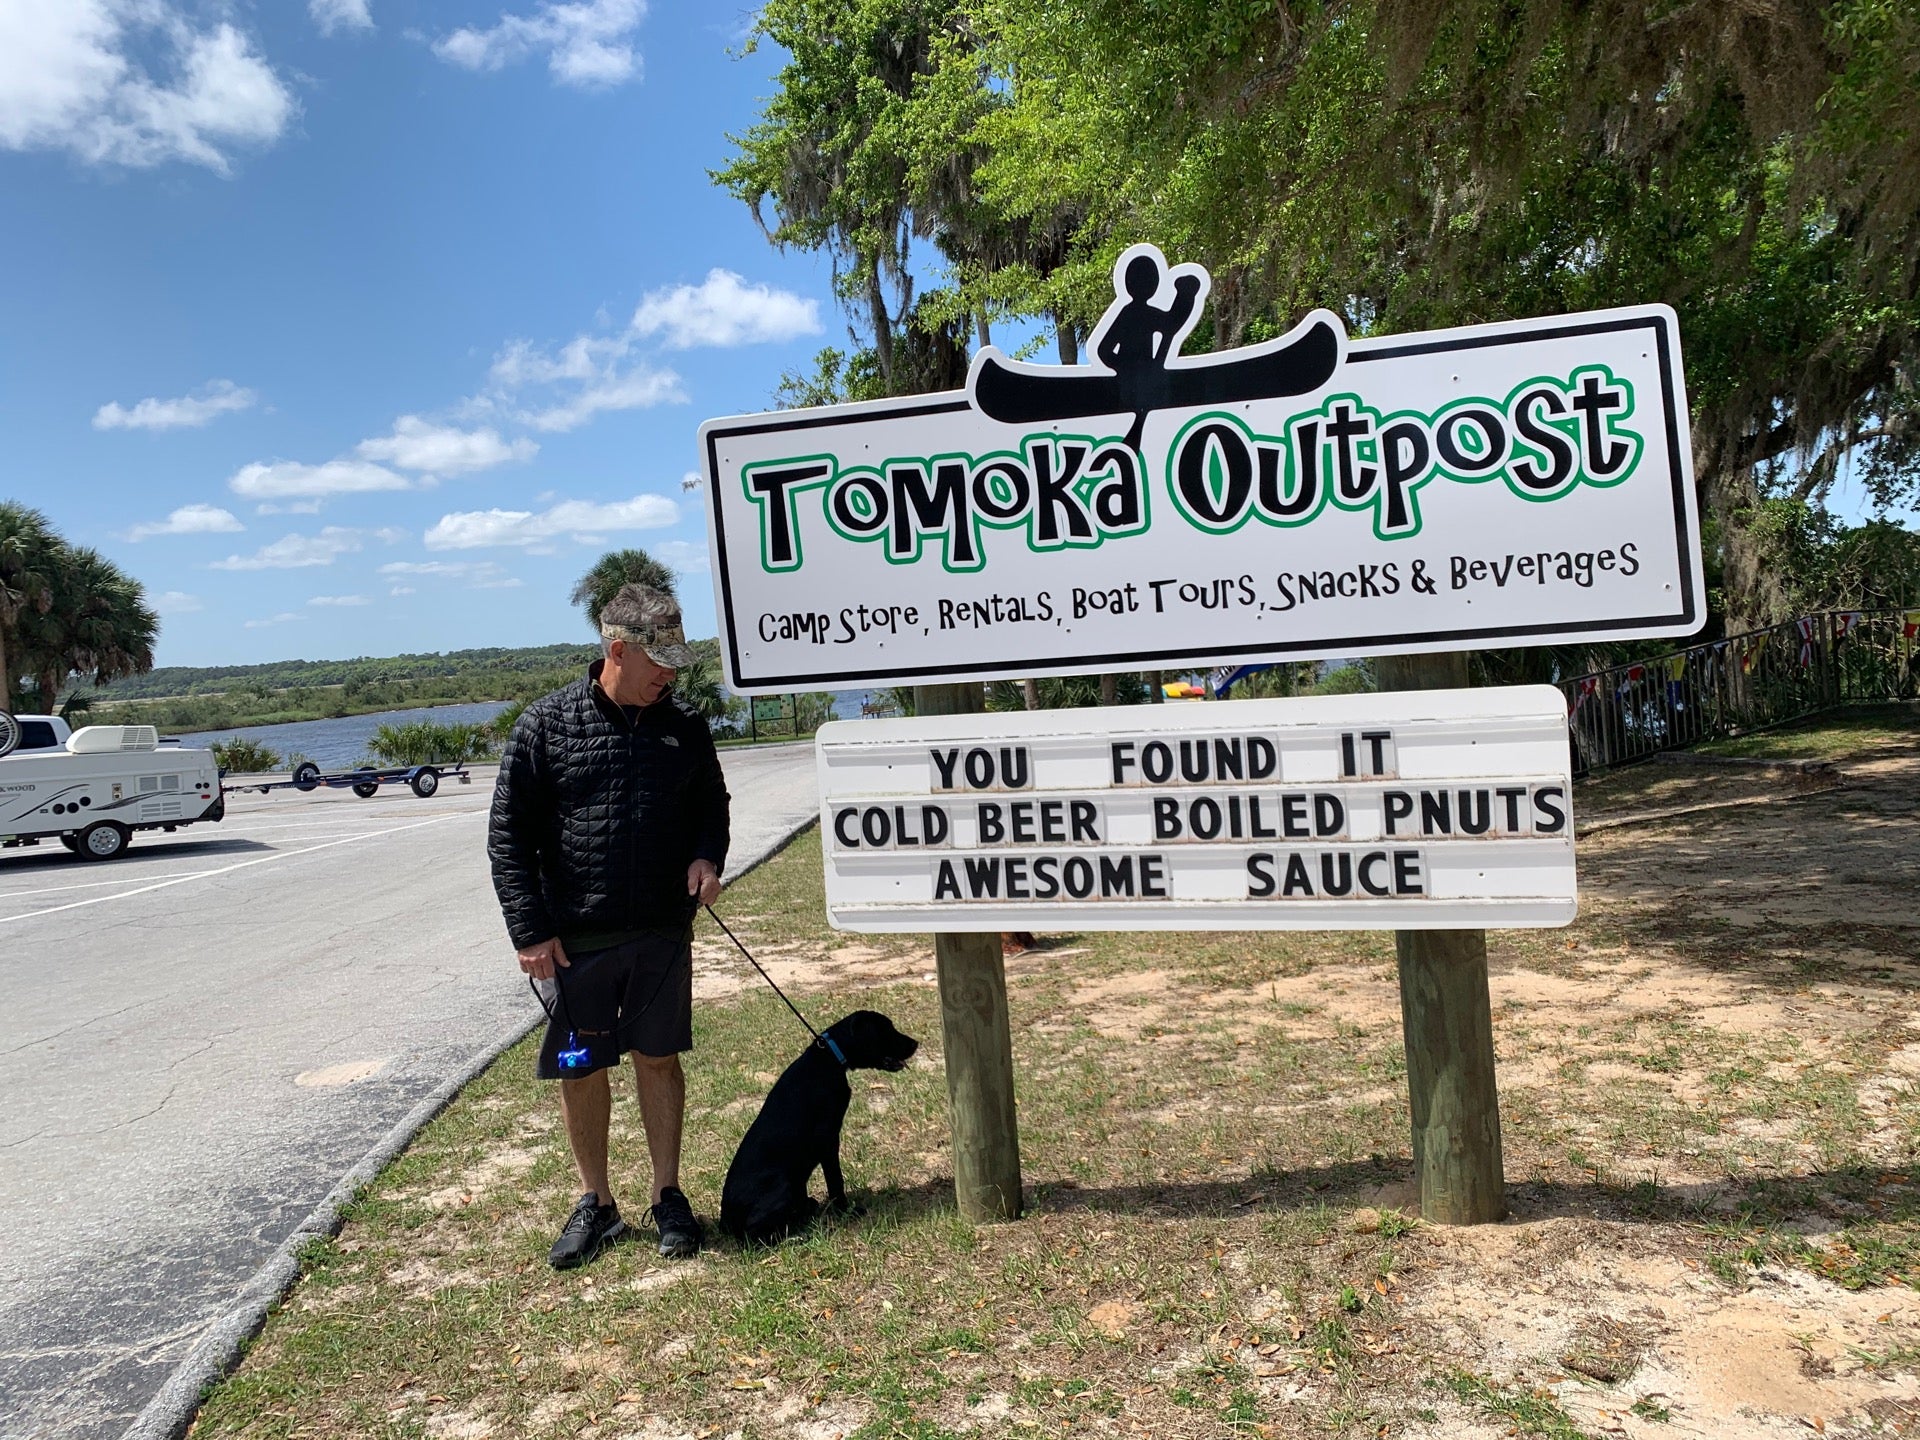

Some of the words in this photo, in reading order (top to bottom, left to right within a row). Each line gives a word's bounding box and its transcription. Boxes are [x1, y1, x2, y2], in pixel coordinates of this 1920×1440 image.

[938, 594, 1063, 629] Rentals,
[1072, 582, 1140, 620] Boat
[1148, 574, 1266, 613] Tours,
[1268, 562, 1400, 612] Snacks
[1411, 559, 1438, 595] &
[1450, 542, 1640, 590] Beverages
[930, 746, 1028, 790] YOU
[1111, 736, 1277, 784] FOUND
[1341, 731, 1392, 777] IT
[834, 804, 949, 848] COLD
[977, 799, 1101, 844] BEER
[1154, 793, 1346, 840] BOILED
[1384, 786, 1566, 835] PNUTS
[934, 855, 1167, 899] AWESOME
[1246, 850, 1424, 897] SAUCE
